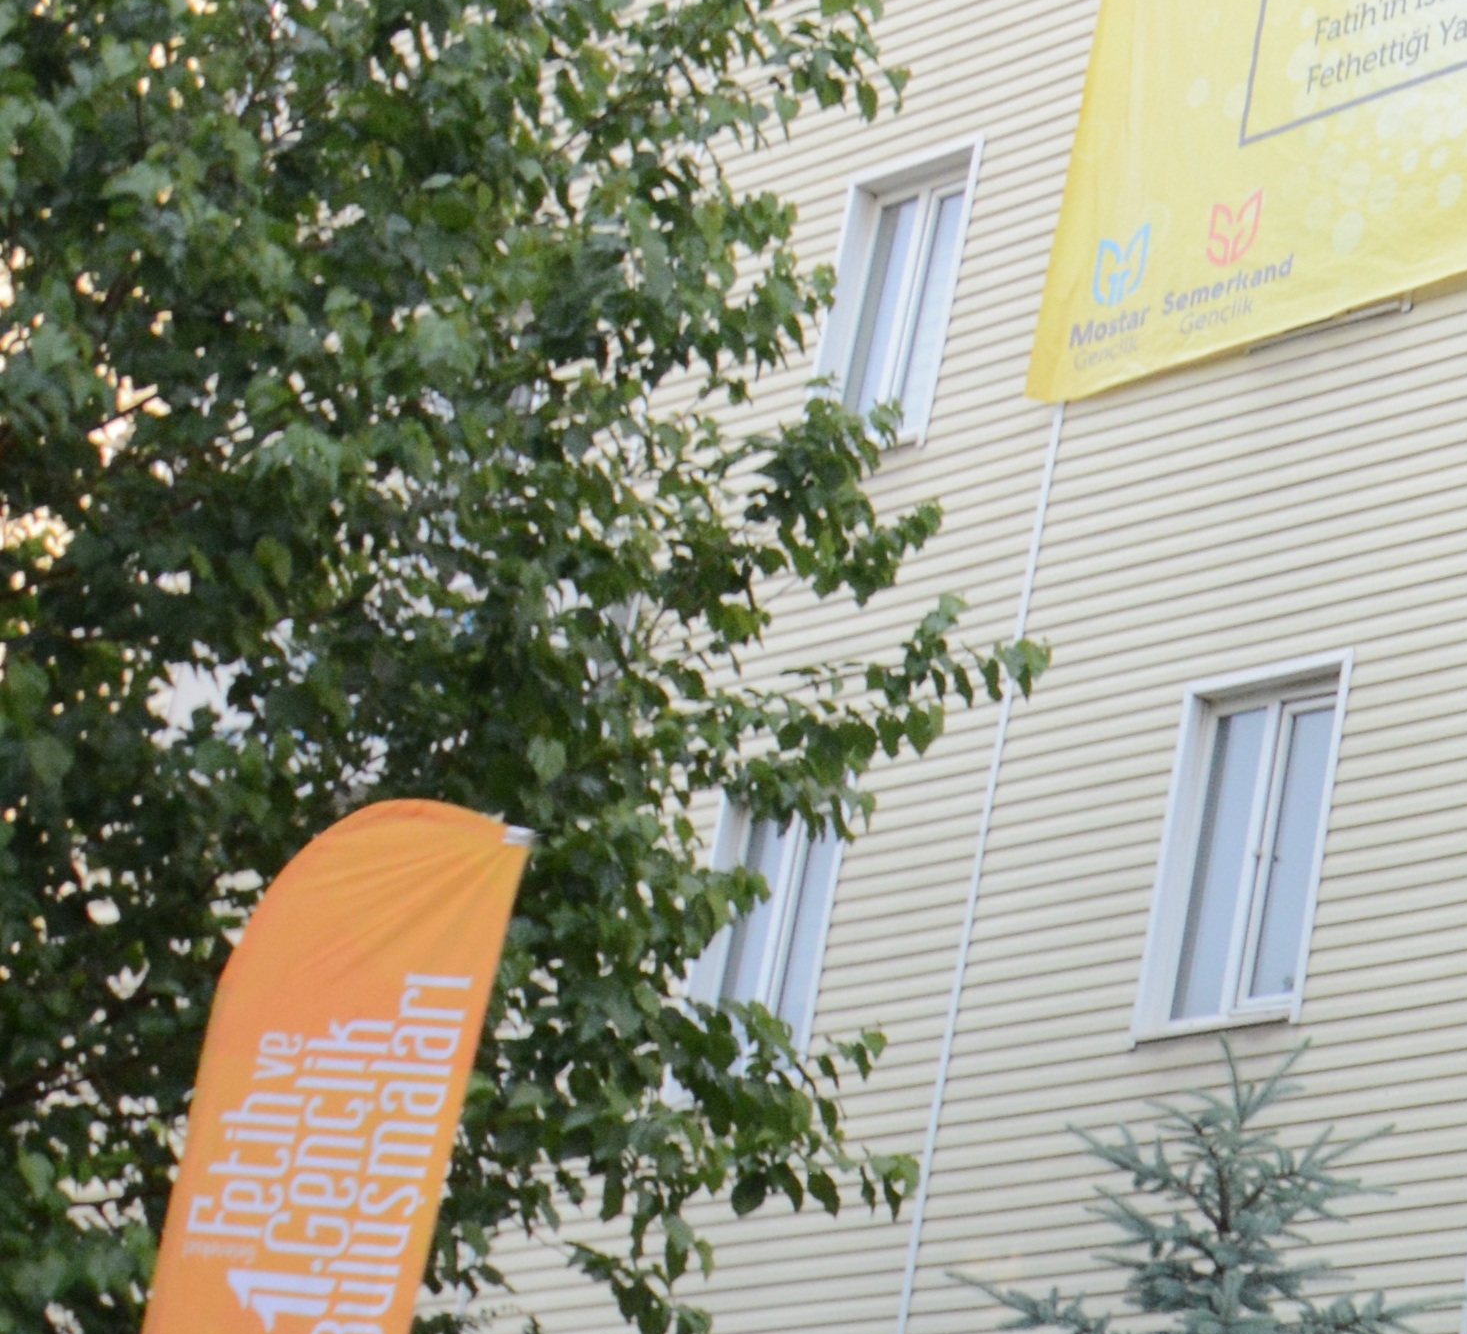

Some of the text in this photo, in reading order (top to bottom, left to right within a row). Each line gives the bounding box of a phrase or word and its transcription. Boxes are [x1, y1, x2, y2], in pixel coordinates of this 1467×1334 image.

[1306, 25, 1430, 94] Fethettiği
[1162, 252, 1294, 315] Semerkand
[1069, 306, 1150, 349] Mostar
[1180, 298, 1253, 335] Gençlik
[186, 1091, 302, 1239] Fetih
[253, 1031, 302, 1079] ve
